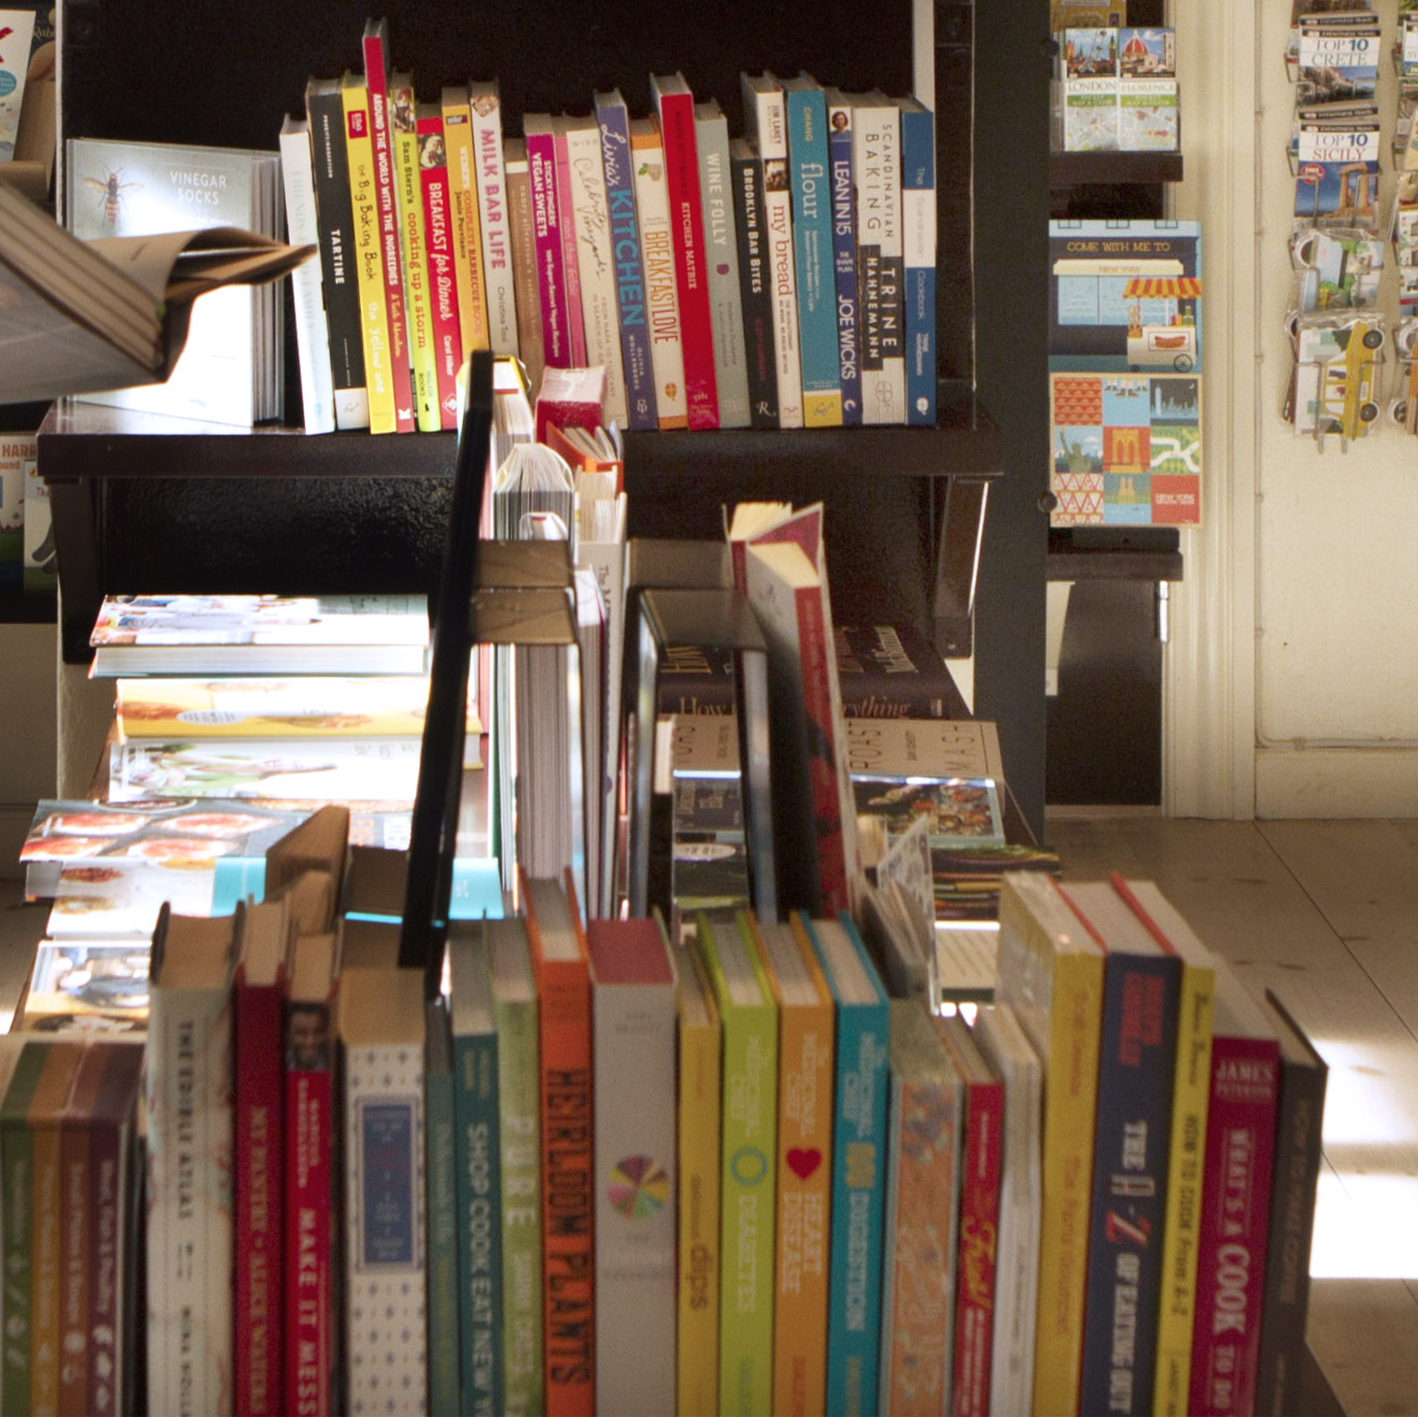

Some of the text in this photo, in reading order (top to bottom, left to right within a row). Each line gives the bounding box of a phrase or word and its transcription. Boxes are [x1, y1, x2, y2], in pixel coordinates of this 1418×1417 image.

[1312, 52, 1367, 66] CRETE
[865, 134, 881, 231] BAKING
[882, 124, 894, 238] SCANDINAVIAN
[1312, 148, 1365, 161] SICILY
[705, 153, 726, 246] WINE FOLLY
[330, 229, 345, 284] TARTINE
[609, 188, 645, 326] KITCHEN
[866, 257, 879, 359] HAHNEMANN
[881, 267, 897, 348] TRINE
[1, 444, 38, 458] HARR
